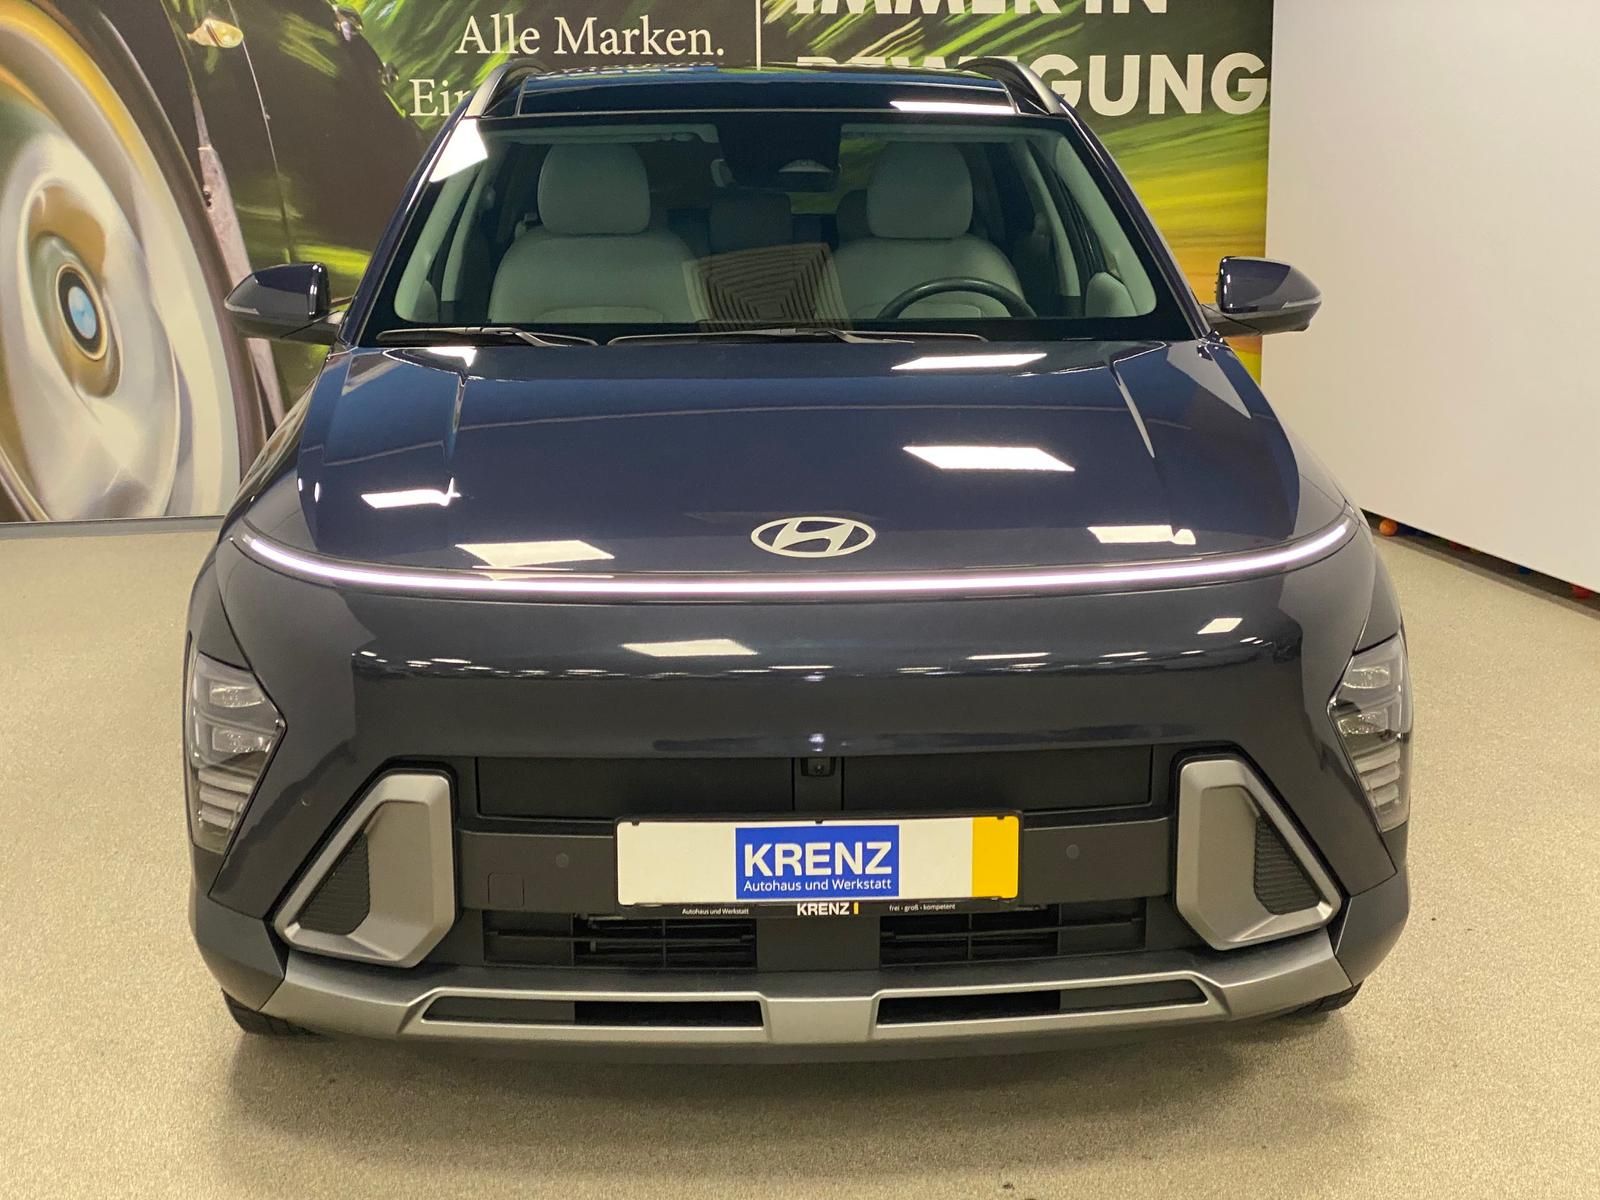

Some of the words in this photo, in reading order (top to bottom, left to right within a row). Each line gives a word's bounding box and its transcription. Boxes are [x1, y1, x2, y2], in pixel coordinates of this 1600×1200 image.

[455, 14, 541, 55] Alle
[554, 14, 725, 57] Marken.
[743, 841, 893, 878] KRENZ
[743, 879, 802, 892] Autohaus
[805, 879, 829, 891] und
[831, 877, 892, 891] Werkstatt
[796, 901, 850, 916] KRENZ
